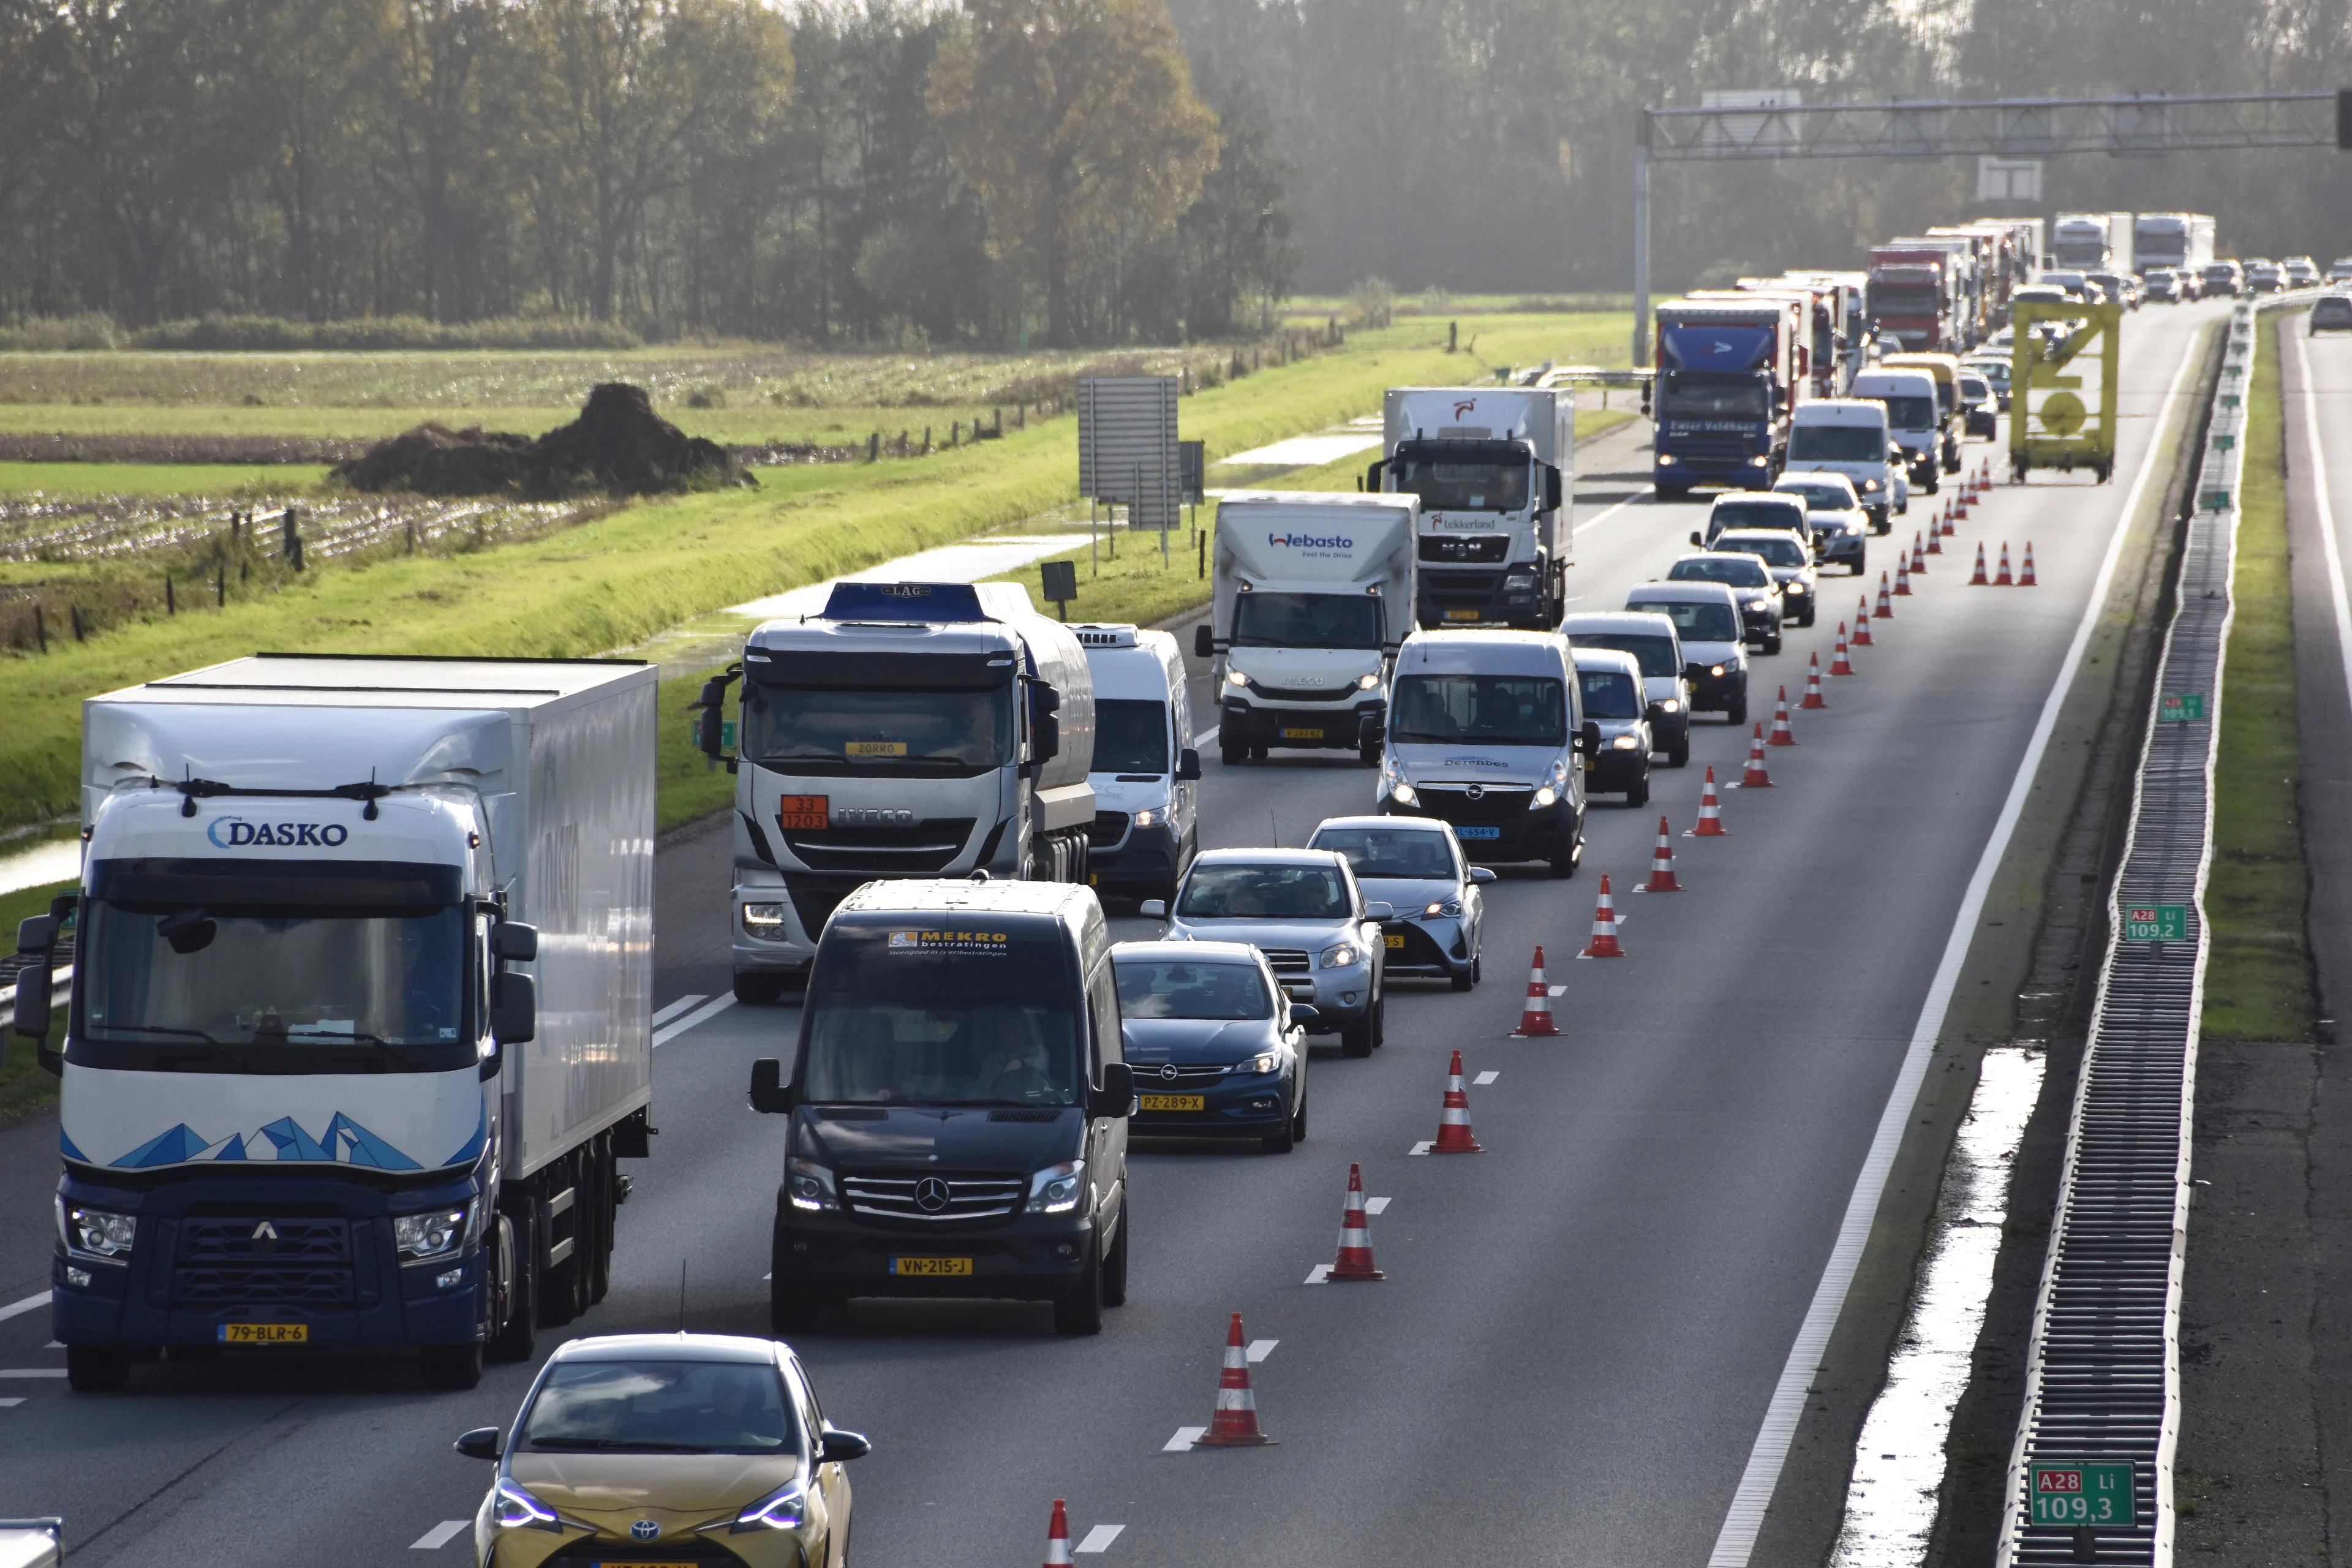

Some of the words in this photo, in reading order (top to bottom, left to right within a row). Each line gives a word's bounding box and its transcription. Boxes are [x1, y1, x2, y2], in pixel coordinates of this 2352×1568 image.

[1445, 519, 1494, 529] Lekkerland
[1268, 533, 1352, 548] Webasto
[894, 586, 920, 596] LAG
[1282, 677, 1324, 685] IVECO
[859, 744, 894, 753] ZORRO
[797, 798, 815, 811] 33
[787, 815, 823, 828] 1203
[839, 809, 913, 824] IVECO
[228, 823, 348, 846] DASKO
[2132, 910, 2155, 921] A28
[921, 932, 1007, 942] MEKRO
[2130, 924, 2174, 939] 109,2
[1144, 1097, 1199, 1108] PZ-289-X
[904, 1260, 965, 1273] VN-215-J
[231, 1326, 302, 1340] 79-BLR-6
[2040, 1474, 2079, 1490] A28
[2100, 1474, 2114, 1490] Li
[2037, 1497, 2112, 1522] 109,3
